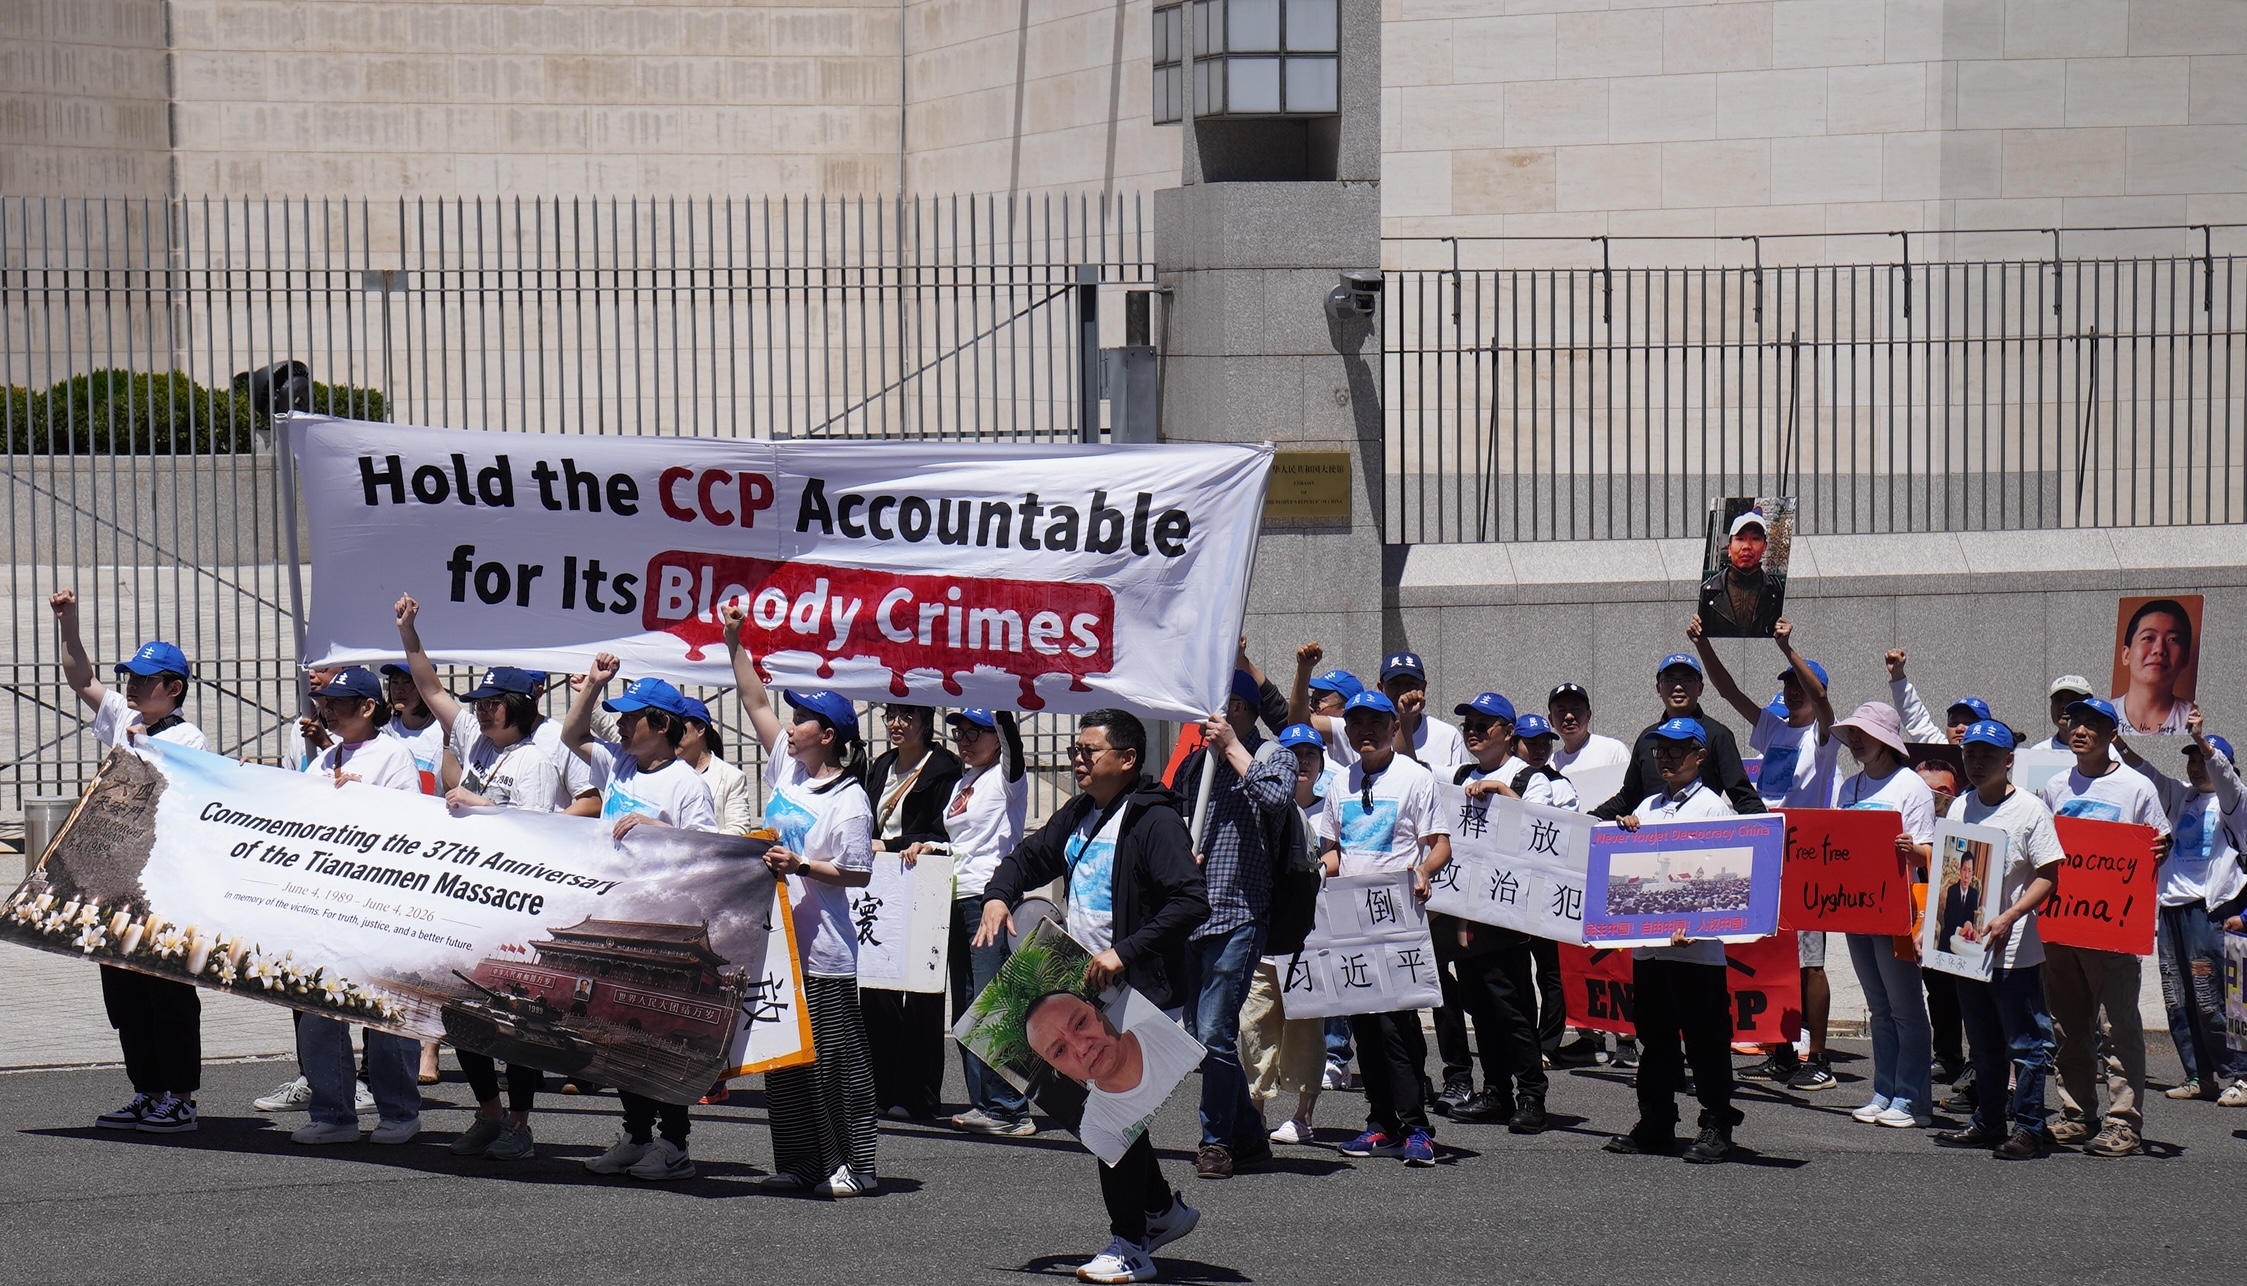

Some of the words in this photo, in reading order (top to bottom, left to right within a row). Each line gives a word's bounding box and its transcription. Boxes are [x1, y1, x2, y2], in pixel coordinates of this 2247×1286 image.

[358, 453, 515, 508] Hold
[531, 458, 640, 516] the
[658, 466, 775, 529] CCP
[795, 477, 1192, 558] Accountable
[447, 544, 544, 607] for
[562, 555, 638, 614] Its
[656, 565, 862, 651] Bloody
[876, 586, 1103, 659] Crimes
[1390, 655, 1416, 668] 民主
[200, 801, 382, 854] Commemorating
[381, 833, 422, 855] the
[422, 840, 481, 866] 37th
[479, 851, 624, 896] Anniversary
[1457, 804, 1560, 857] 释放
[1595, 831, 1630, 845] Never
[1631, 829, 1668, 845] forget
[1671, 827, 1735, 842] Democracy
[1737, 825, 1770, 838] China
[1785, 826, 1818, 863] Free
[1822, 833, 1851, 866] free
[230, 840, 264, 859] of
[259, 845, 300, 868] the
[304, 850, 430, 892] Tiananmen
[431, 872, 544, 916] Massacre
[1430, 857, 1583, 921] 政治犯
[223, 890, 233, 899] In
[232, 893, 265, 906] memory
[265, 898, 276, 906] of
[275, 899, 289, 910] the
[290, 902, 320, 916] victims.
[322, 908, 337, 920] For
[337, 912, 359, 926] truth,
[360, 917, 391, 933] justice,
[393, 925, 411, 937] and
[411, 930, 417, 938] a
[418, 929, 445, 944] better
[445, 936, 474, 952] future.
[282, 881, 310, 896] June
[311, 887, 321, 899] 4,
[324, 889, 354, 904] 1989
[362, 897, 391, 912] June
[392, 904, 402, 916] 4,
[405, 906, 436, 922] 2026
[1365, 887, 1396, 925] 倒
[2038, 894, 2134, 927] hina!
[1288, 948, 1425, 990] 习近平
[528, 1004, 544, 1015] 1989
[618, 991, 715, 1020] 世界人民大团结万岁
[1585, 977, 1634, 1024] EN
